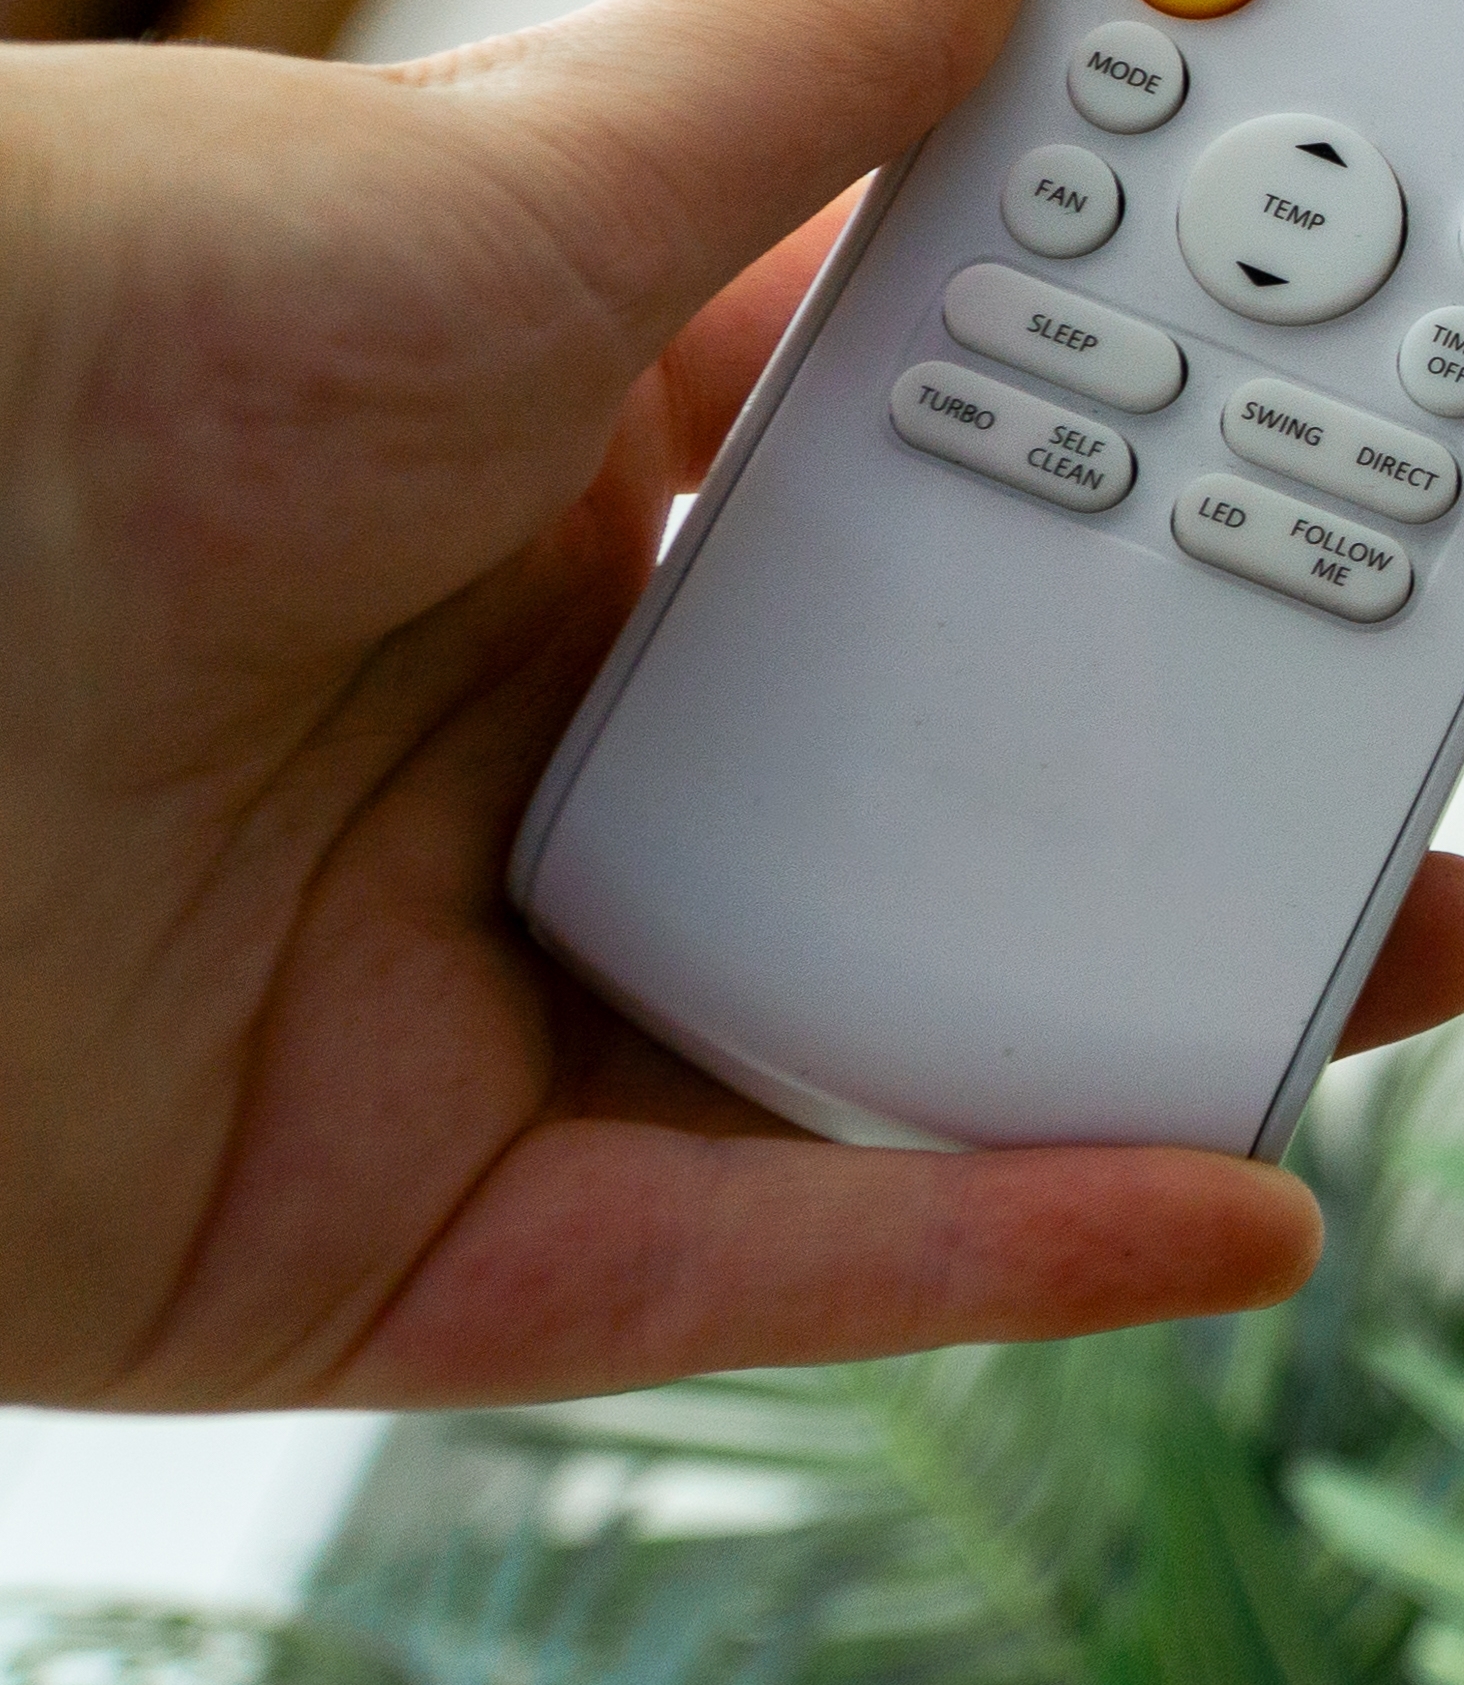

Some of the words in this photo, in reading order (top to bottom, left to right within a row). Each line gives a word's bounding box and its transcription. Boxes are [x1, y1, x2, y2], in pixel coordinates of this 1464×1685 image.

[1087, 50, 1163, 96] MODE
[1034, 178, 1088, 214] FAN
[1262, 193, 1327, 232] TEMP
[1026, 313, 1099, 354] SLEEP
[917, 385, 996, 432] TURBO
[1241, 400, 1324, 448] SWING
[1049, 424, 1106, 459] SELF
[1027, 447, 1104, 491] CLEAN
[1356, 443, 1439, 494] DIRECT
[1199, 497, 1246, 530] LED
[1290, 518, 1393, 572] FOLLOW
[1311, 557, 1351, 588] ME
